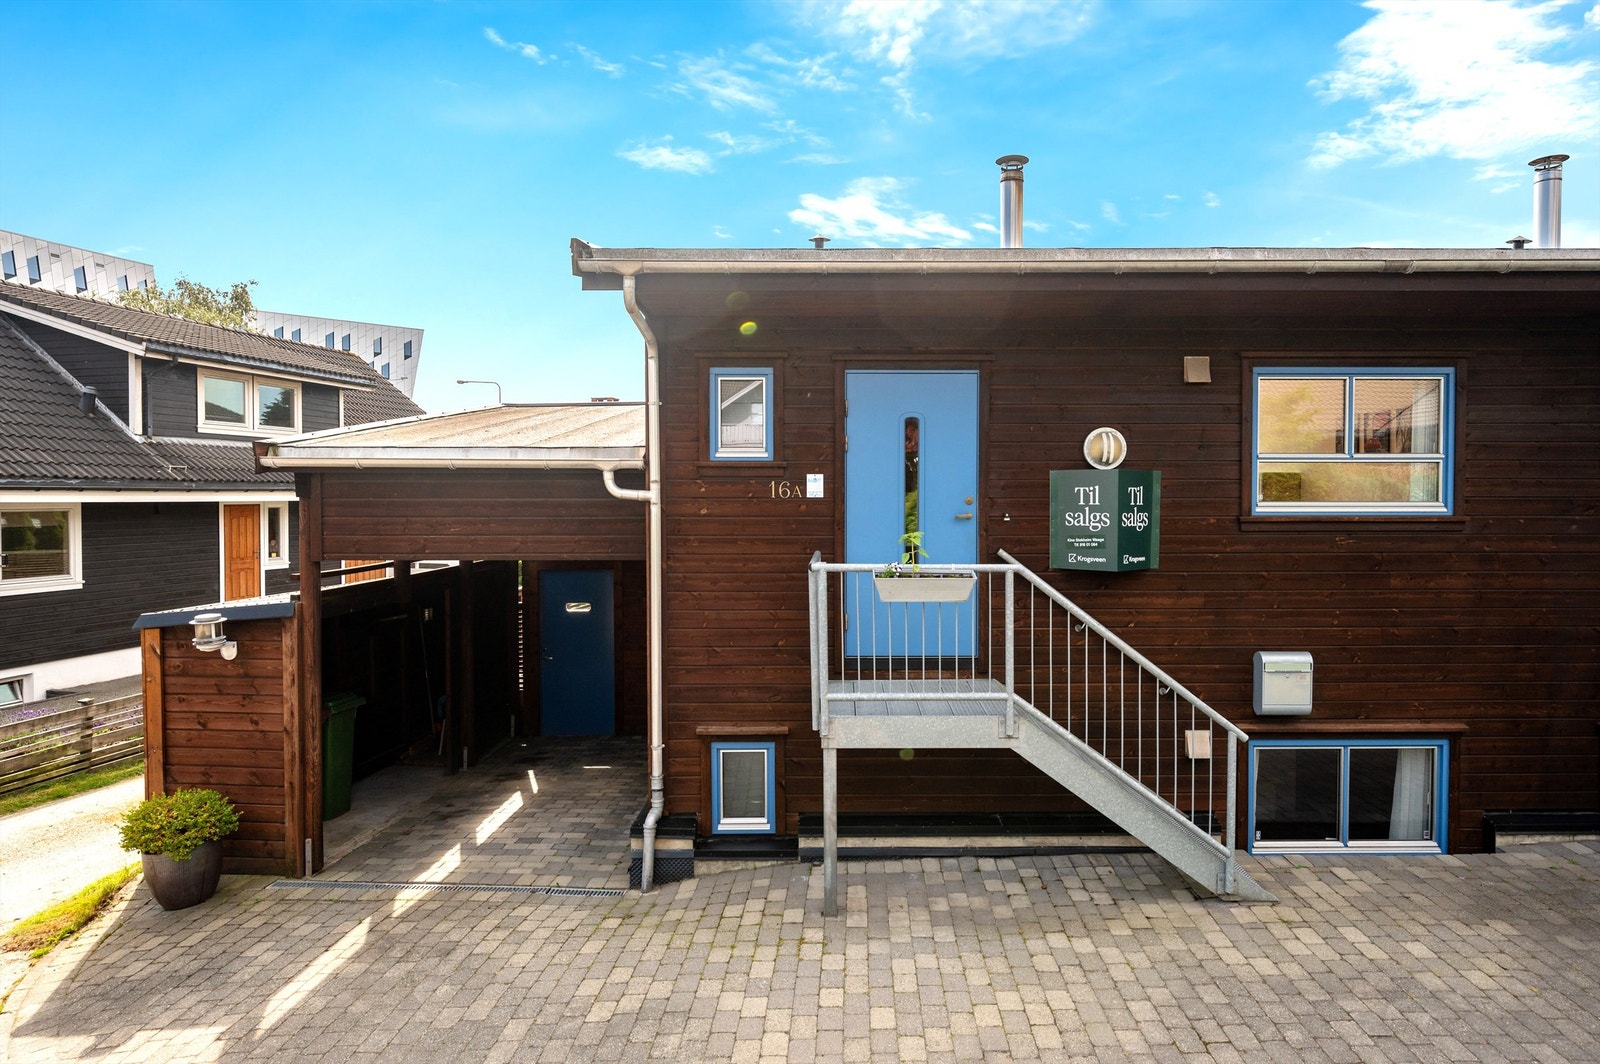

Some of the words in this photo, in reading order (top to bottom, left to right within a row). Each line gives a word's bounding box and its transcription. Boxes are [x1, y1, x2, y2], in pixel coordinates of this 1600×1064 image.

[769, 481, 802, 498] 16A
[1074, 485, 1100, 505] Til
[1128, 486, 1143, 505] Til
[1065, 507, 1110, 531] salgs
[1121, 507, 1149, 531] salgs
[1077, 555, 1107, 563] Krogsveen
